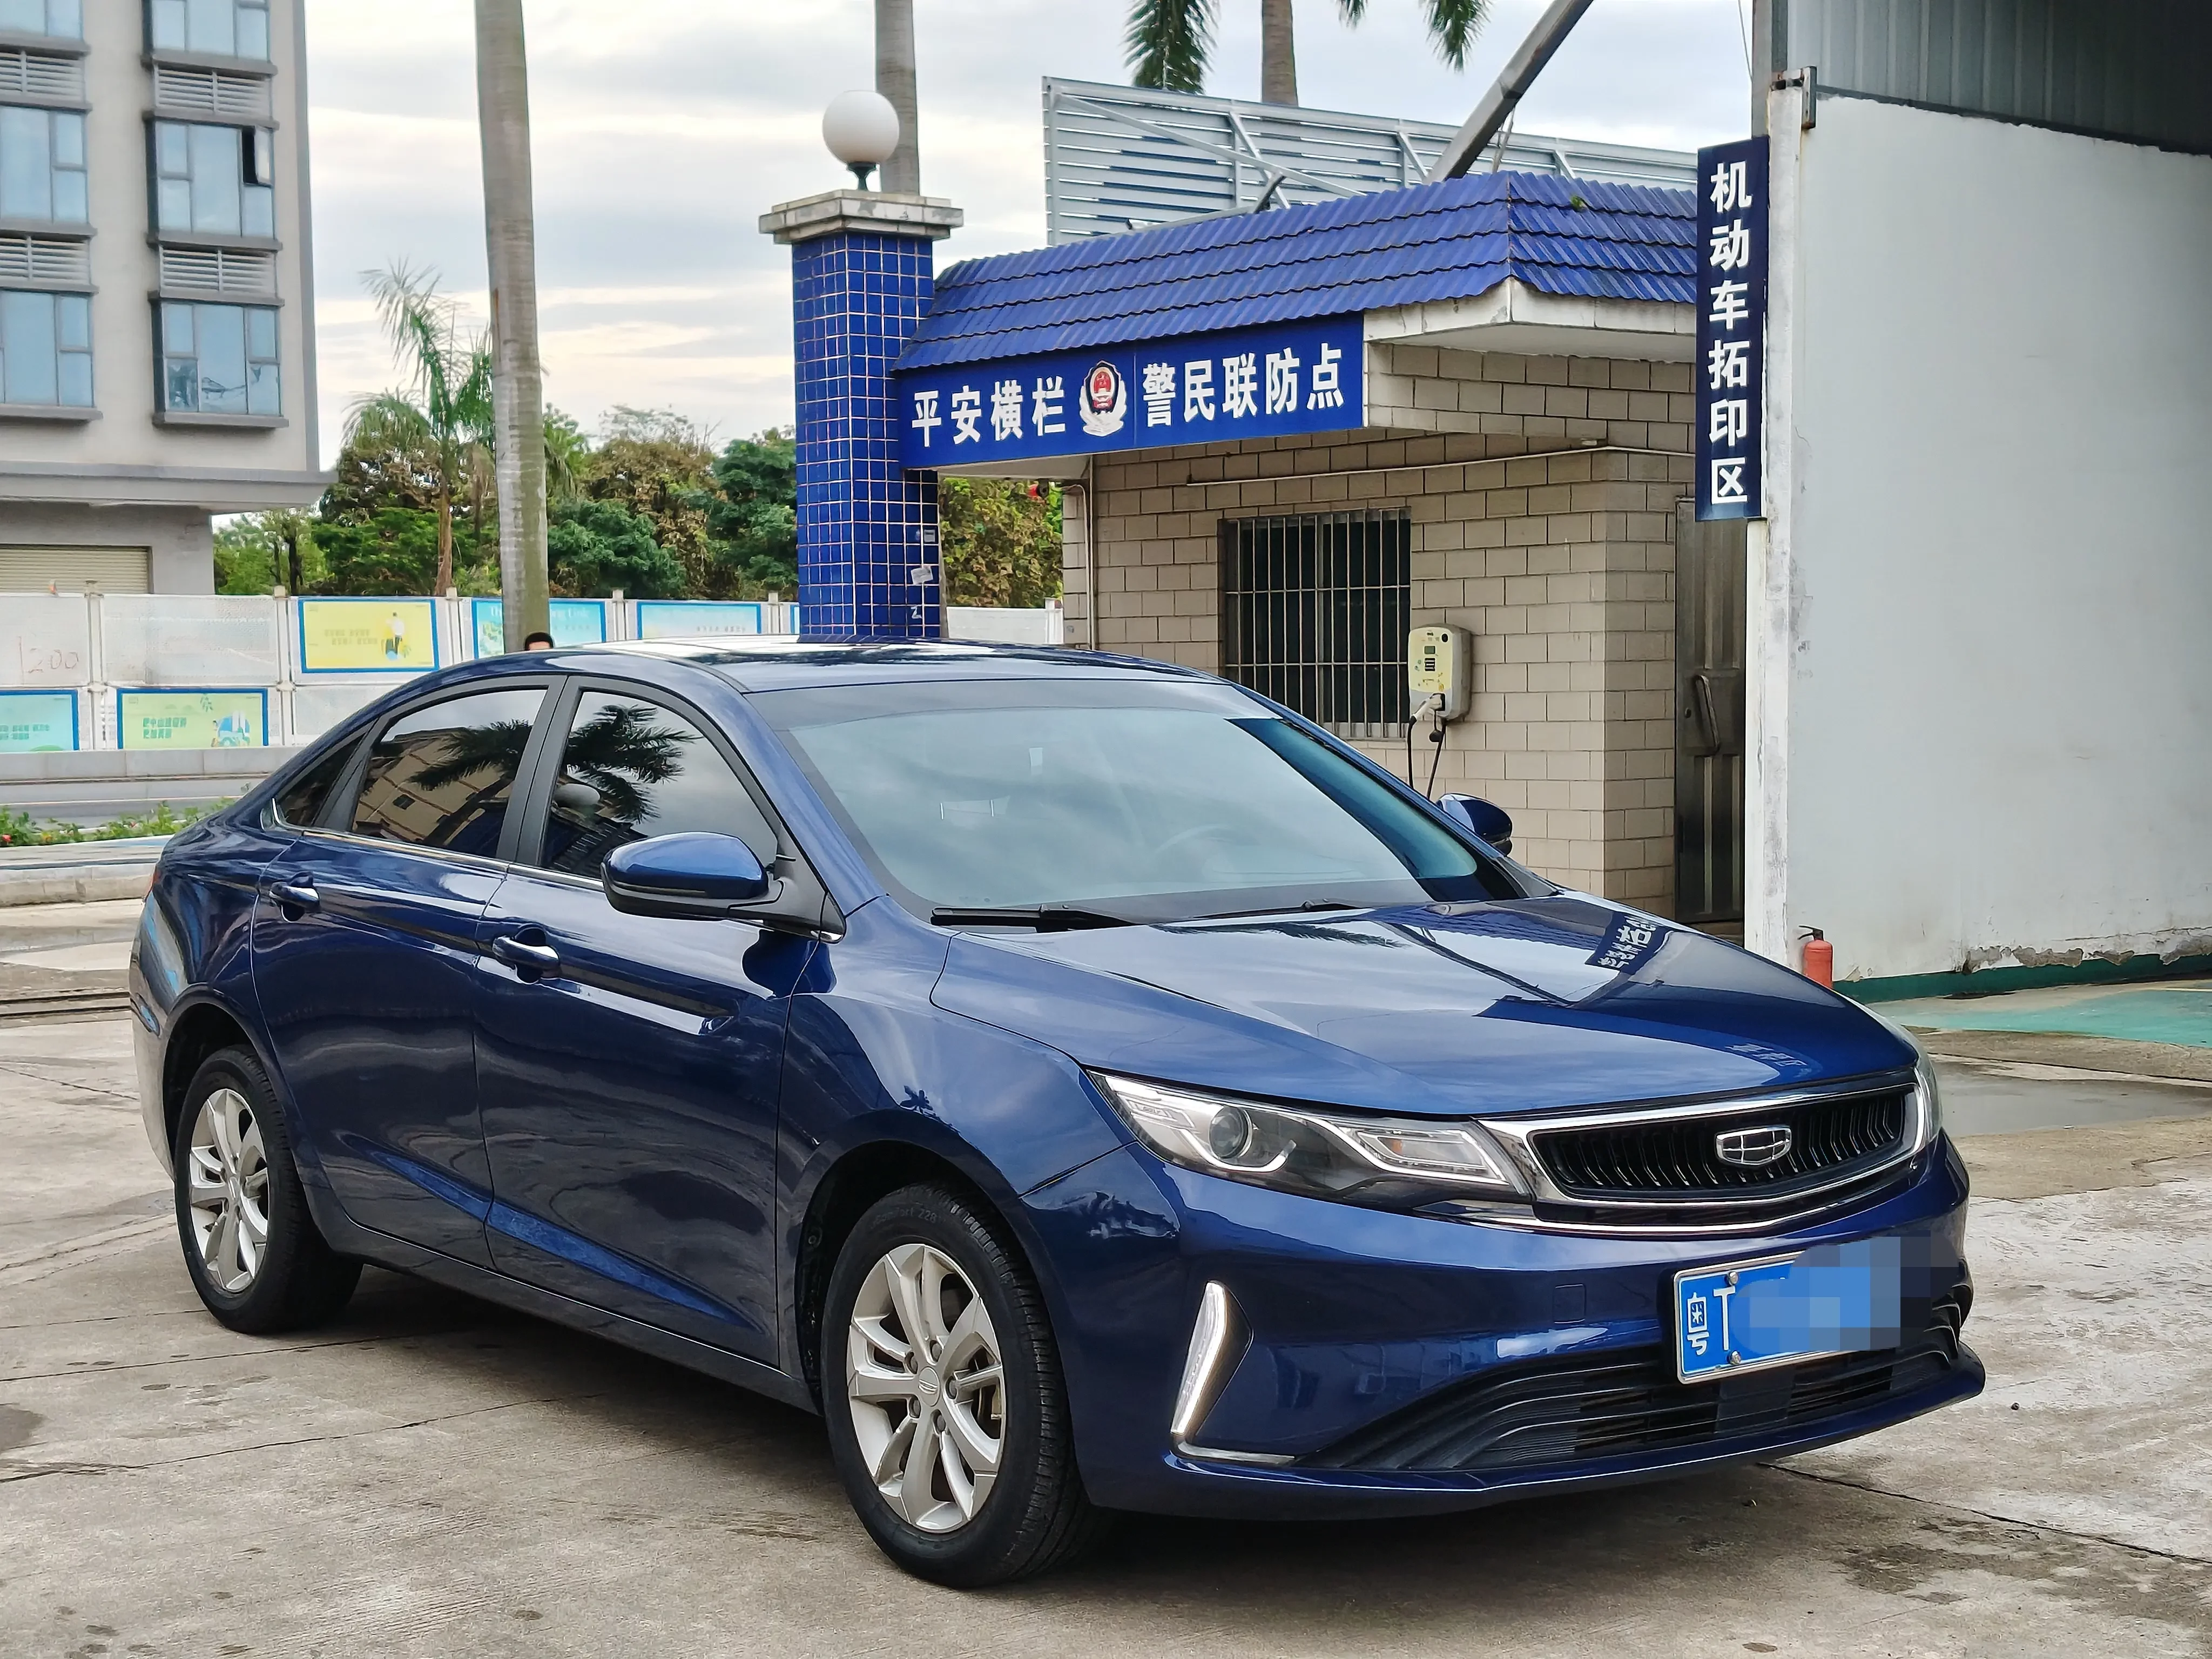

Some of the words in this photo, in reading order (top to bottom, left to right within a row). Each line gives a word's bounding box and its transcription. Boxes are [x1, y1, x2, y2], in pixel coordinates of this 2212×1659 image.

[911, 374, 1067, 449] 平安横栏
[1142, 341, 1346, 428] 警民联防点
[1708, 159, 1752, 505] 机动车拓印区
